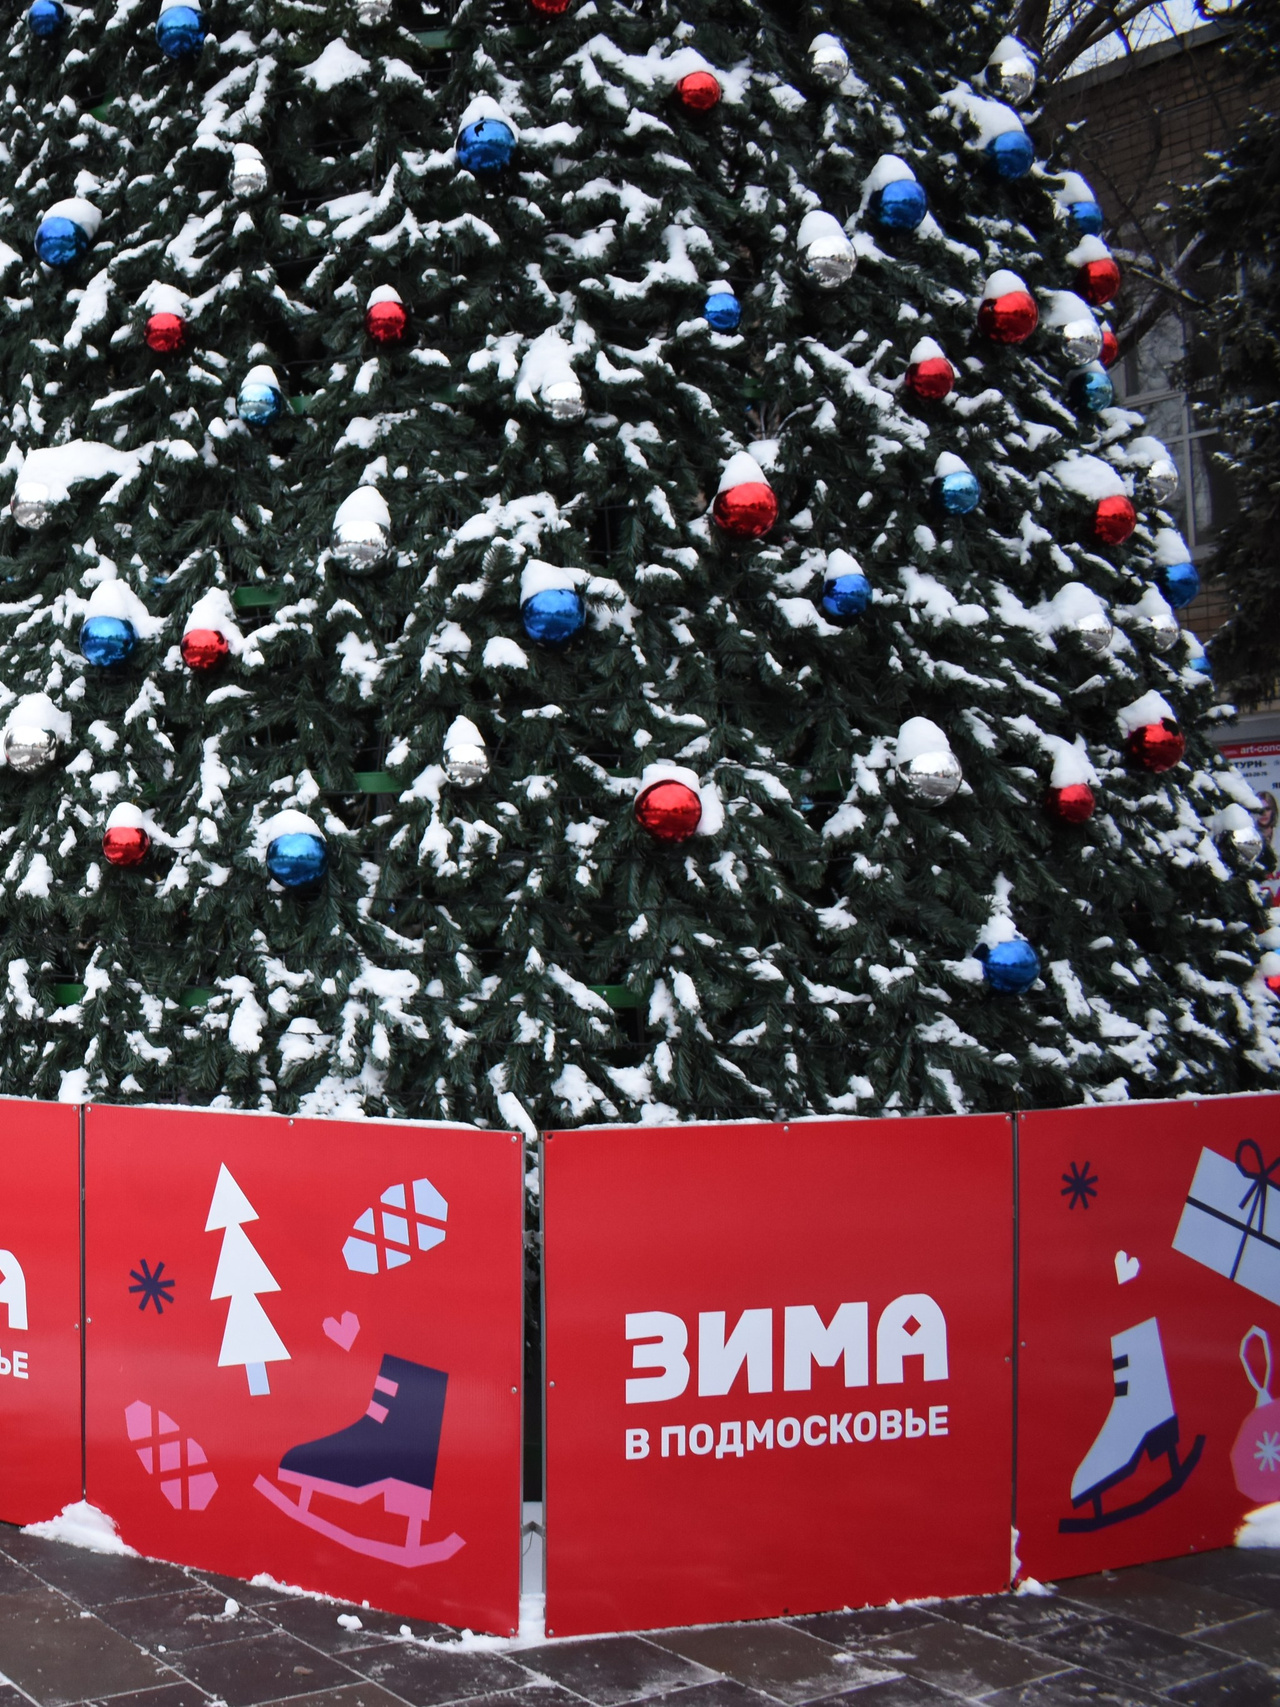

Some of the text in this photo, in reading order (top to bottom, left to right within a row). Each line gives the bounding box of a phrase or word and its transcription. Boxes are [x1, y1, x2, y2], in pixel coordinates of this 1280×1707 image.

[625, 1293, 949, 1405] ЗИМА
[625, 1405, 949, 1460] В ПОДМОСКОВЬЕ
